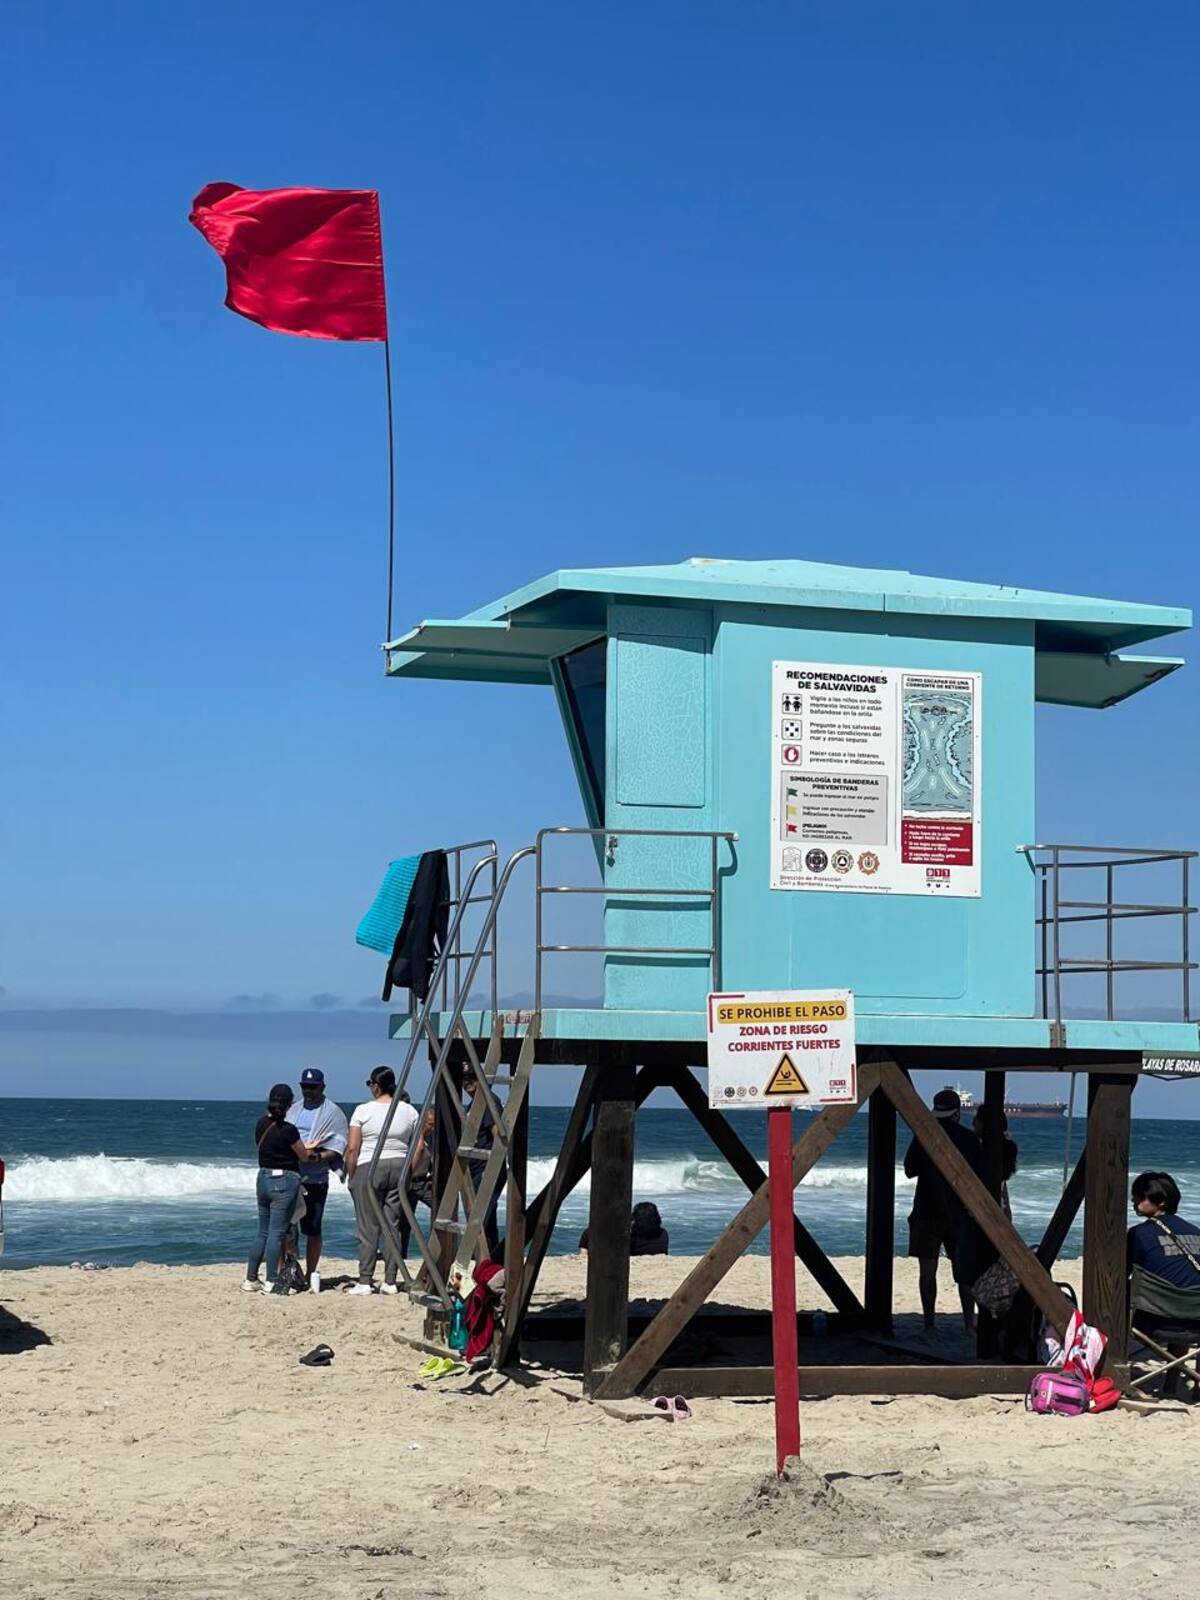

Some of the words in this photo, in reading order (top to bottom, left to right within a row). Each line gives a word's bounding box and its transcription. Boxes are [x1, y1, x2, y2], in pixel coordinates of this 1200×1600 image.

[786, 671, 888, 684] RECOMENDACIONES
[814, 682, 876, 693] SALVAVIDAS
[720, 1008, 734, 1019] SE
[738, 1007, 791, 1019] PROHIBE
[796, 1007, 808, 1016] EL
[813, 1005, 845, 1016] PASO
[740, 1026, 770, 1036] ZONA
[773, 1026, 786, 1035] DE
[790, 1025, 828, 1034] RIESGO
[728, 1042, 793, 1052] CORRIENTES
[796, 1040, 840, 1050] FUERTES
[1164, 1059, 1176, 1070] DE
[1175, 1059, 1200, 1072] ROSAR
